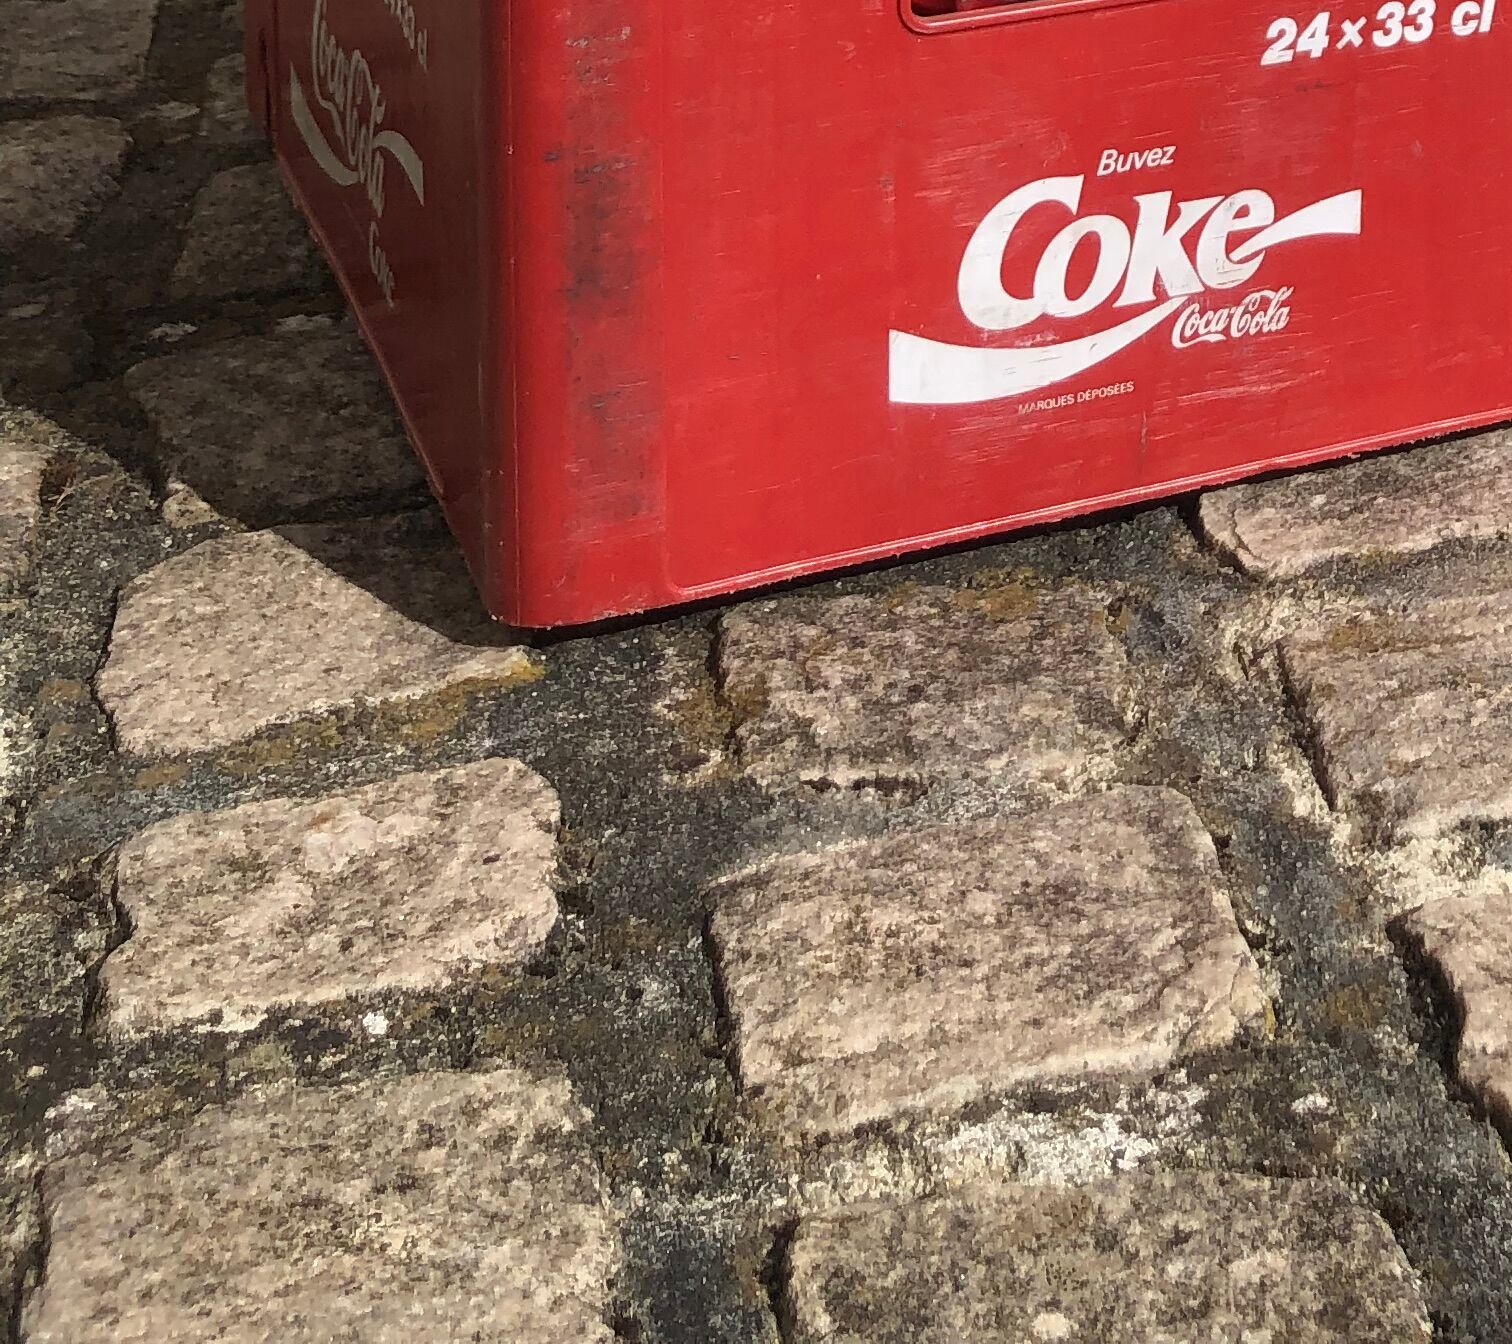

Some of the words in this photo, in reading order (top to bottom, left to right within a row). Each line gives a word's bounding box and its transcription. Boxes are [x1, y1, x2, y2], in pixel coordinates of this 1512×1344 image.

[1096, 145, 1177, 177] Buvez
[957, 174, 1276, 332] Coke
[1172, 285, 1295, 349] Coca-Cola
[1018, 393, 1075, 415] MARQUES
